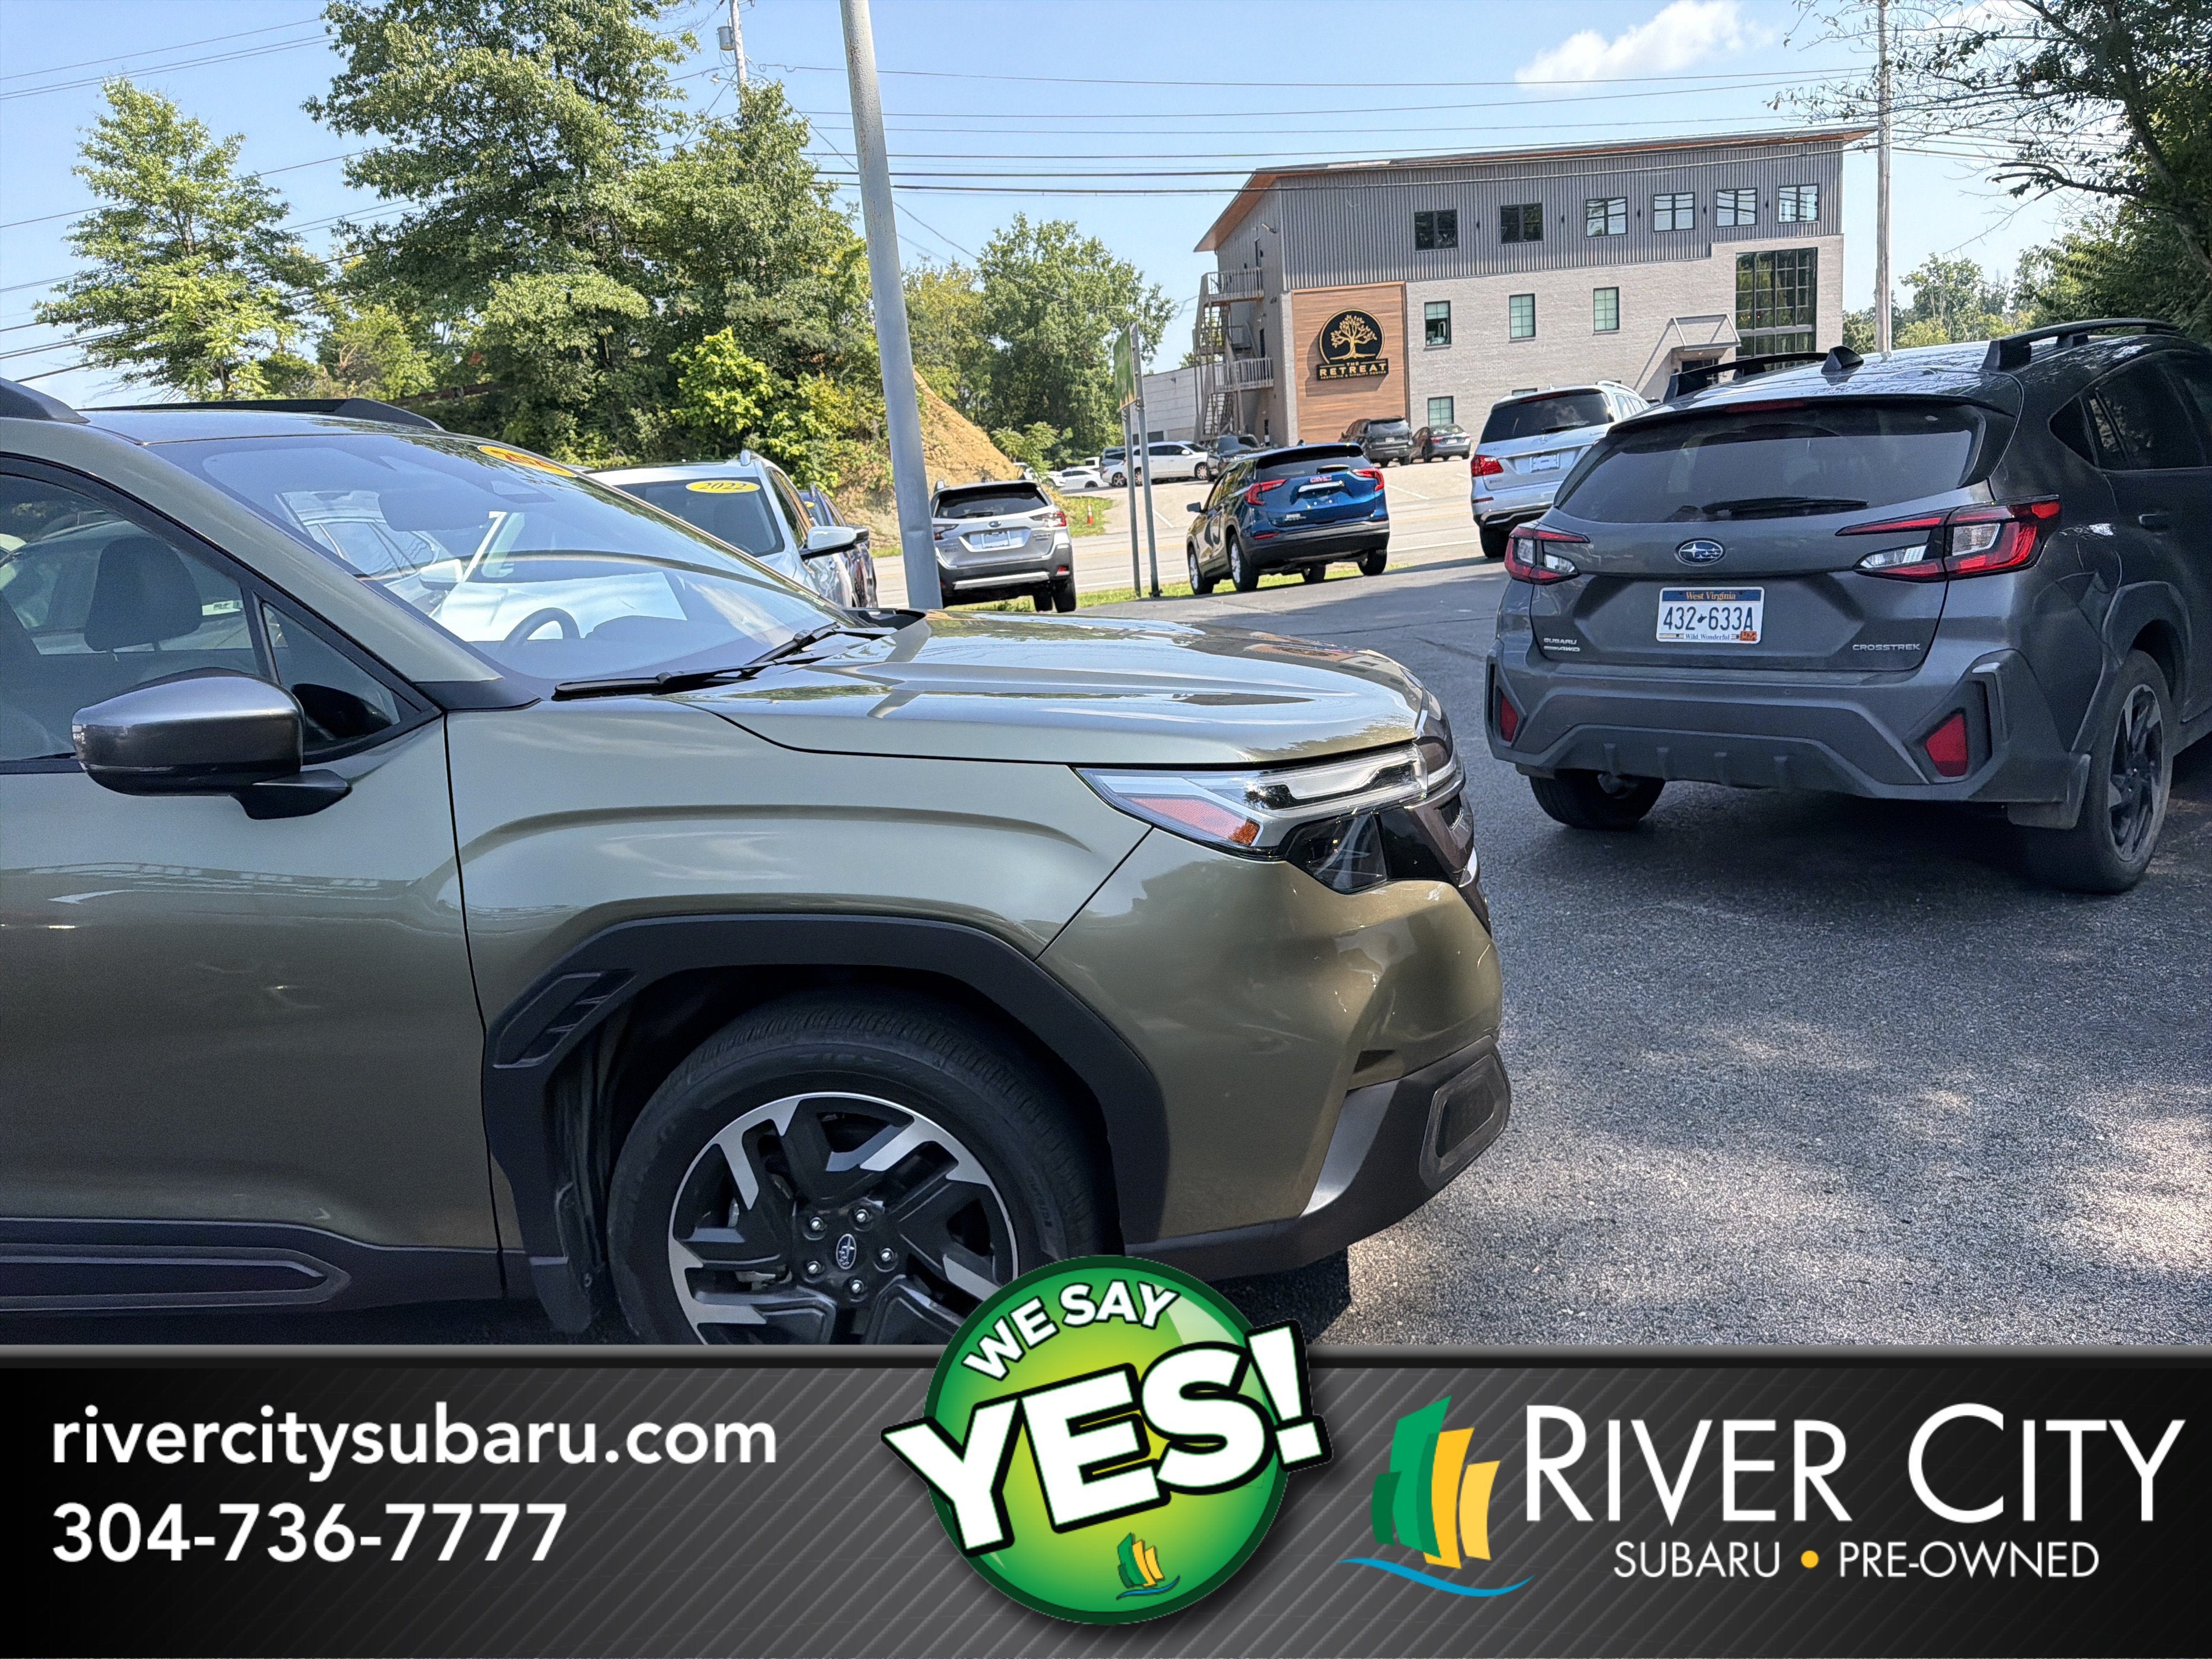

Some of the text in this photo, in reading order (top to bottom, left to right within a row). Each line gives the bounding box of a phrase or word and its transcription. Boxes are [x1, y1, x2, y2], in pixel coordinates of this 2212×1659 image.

[1319, 363, 1386, 376] RETREAT
[1686, 591, 1736, 601] West Virginia
